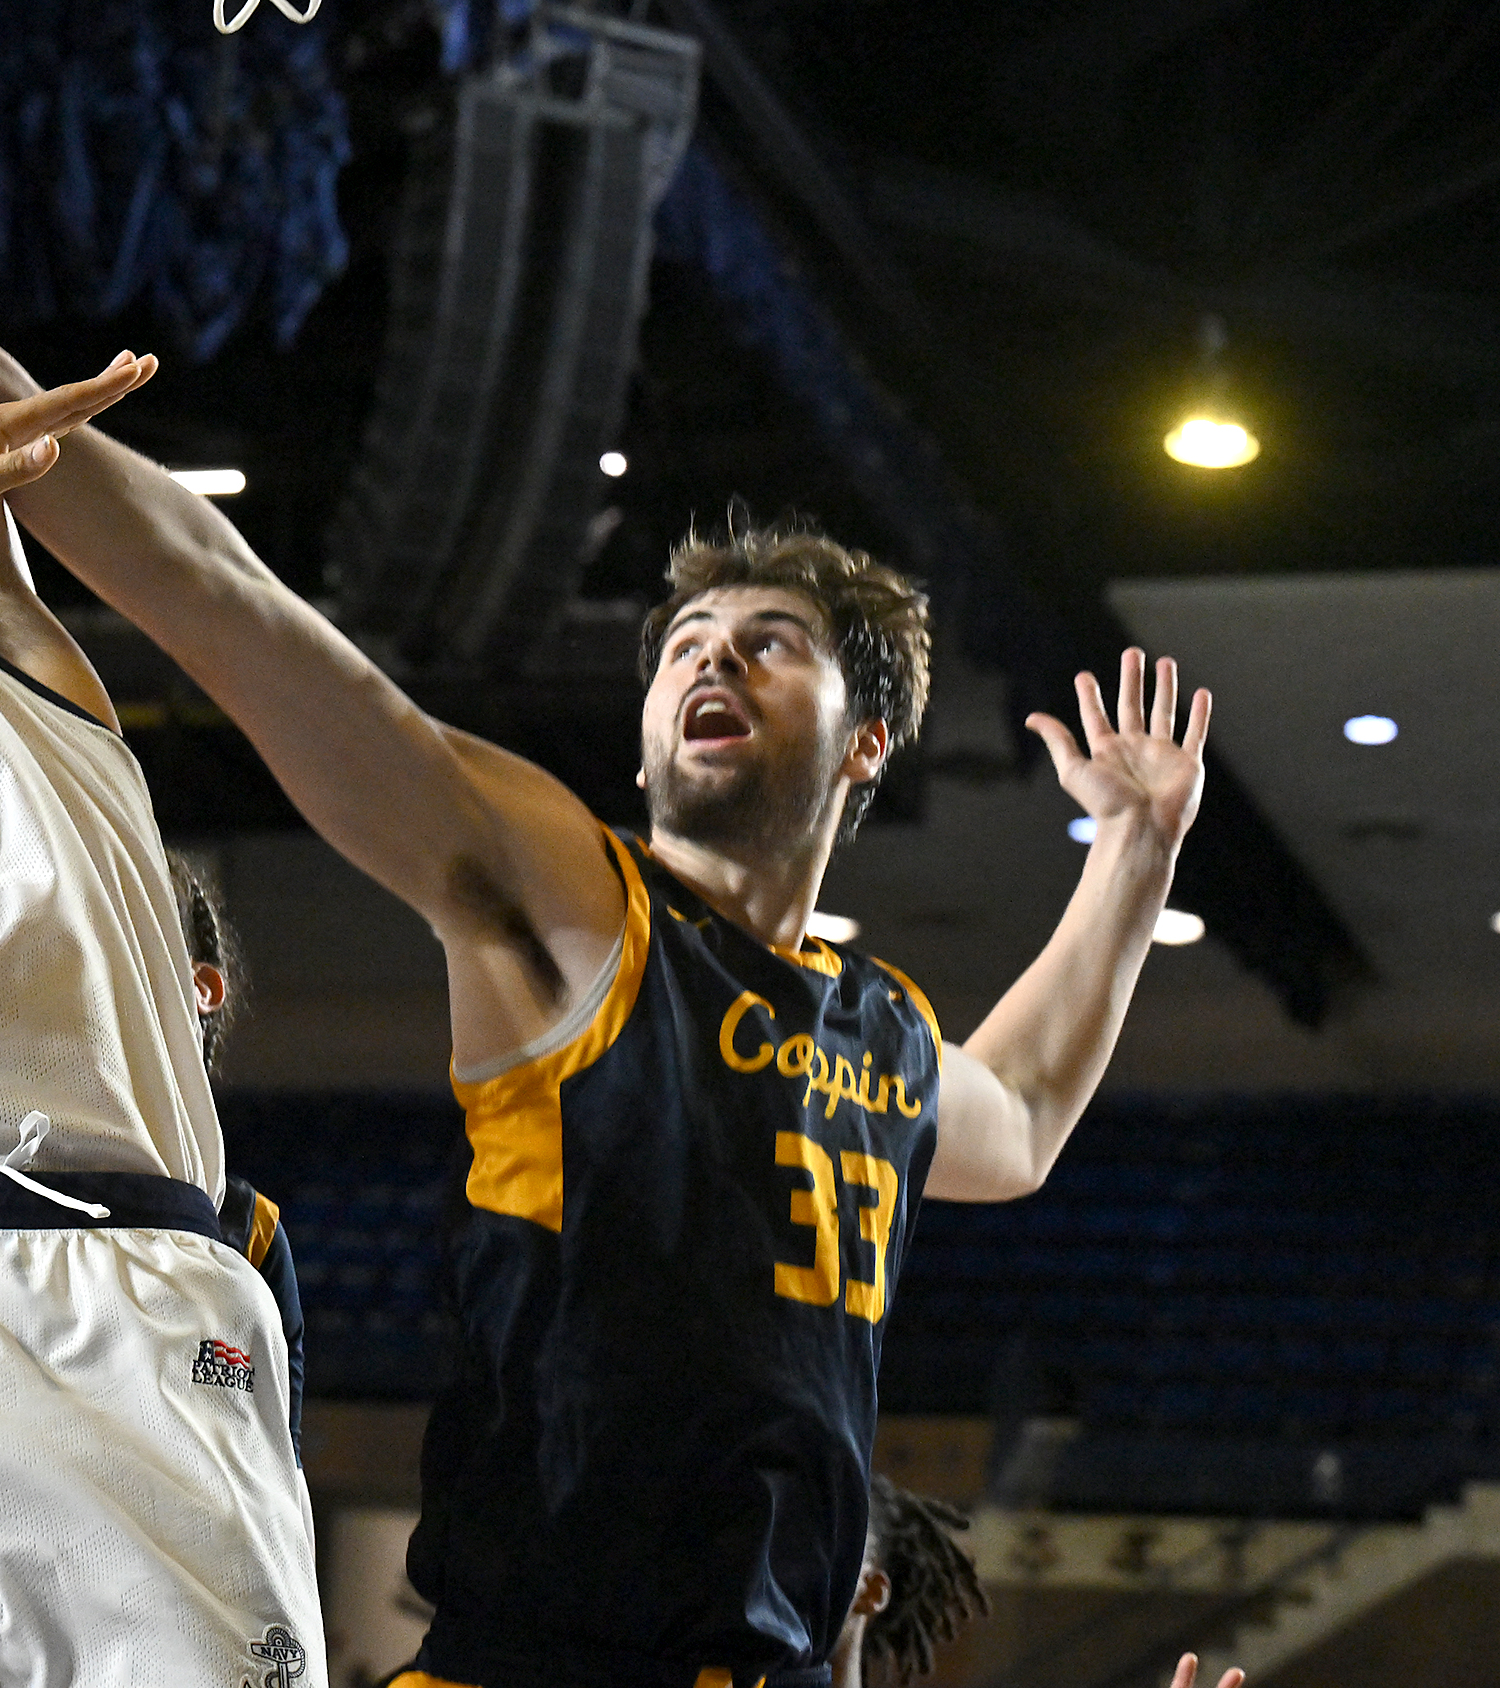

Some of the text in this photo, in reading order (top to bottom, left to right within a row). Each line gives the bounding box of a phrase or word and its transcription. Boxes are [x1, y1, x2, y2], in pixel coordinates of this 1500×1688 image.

[719, 990, 921, 1120] Coppin
[774, 1131, 899, 1325] 33
[191, 1368, 254, 1393] LEAGUE
[192, 1359, 256, 1381] PATRIOT
[260, 1646, 299, 1661] NAVY
